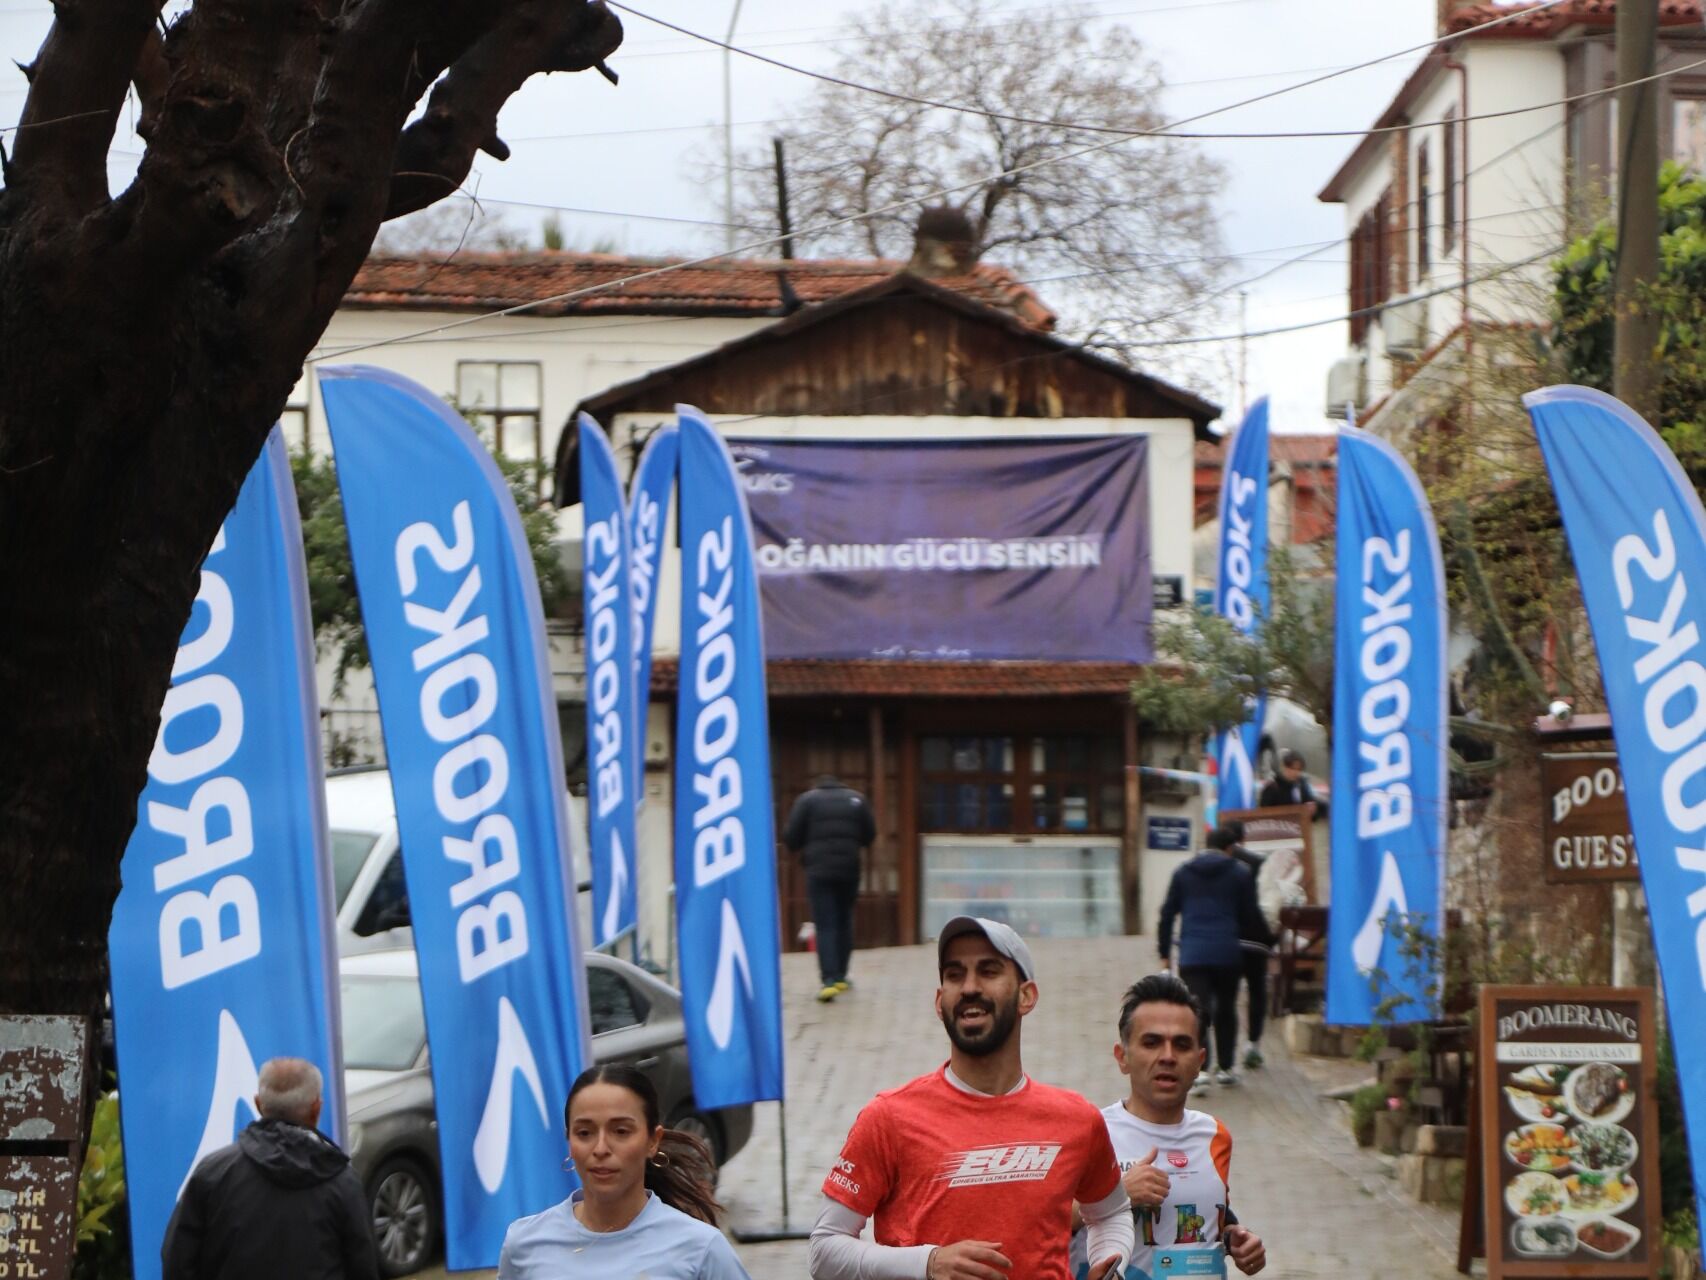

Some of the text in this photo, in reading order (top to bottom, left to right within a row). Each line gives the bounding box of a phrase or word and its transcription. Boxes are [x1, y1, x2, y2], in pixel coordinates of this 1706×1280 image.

[756, 538, 884, 570] OĞANIN
[892, 538, 982, 569] GÜCÜ
[1225, 471, 1257, 629] OOKS
[1553, 768, 1624, 823] BOO
[1498, 1004, 1637, 1040] BOOMERANG
[1510, 1047, 1633, 1058] GARDEN RESTAURANT
[956, 1146, 1062, 1176] EUM
[952, 1177, 983, 1185] EPHESUS
[1010, 1172, 1046, 1180] MARATHON
[20, 1214, 43, 1230] TL
[18, 1239, 40, 1253] TL
[16, 1263, 39, 1277] TL
